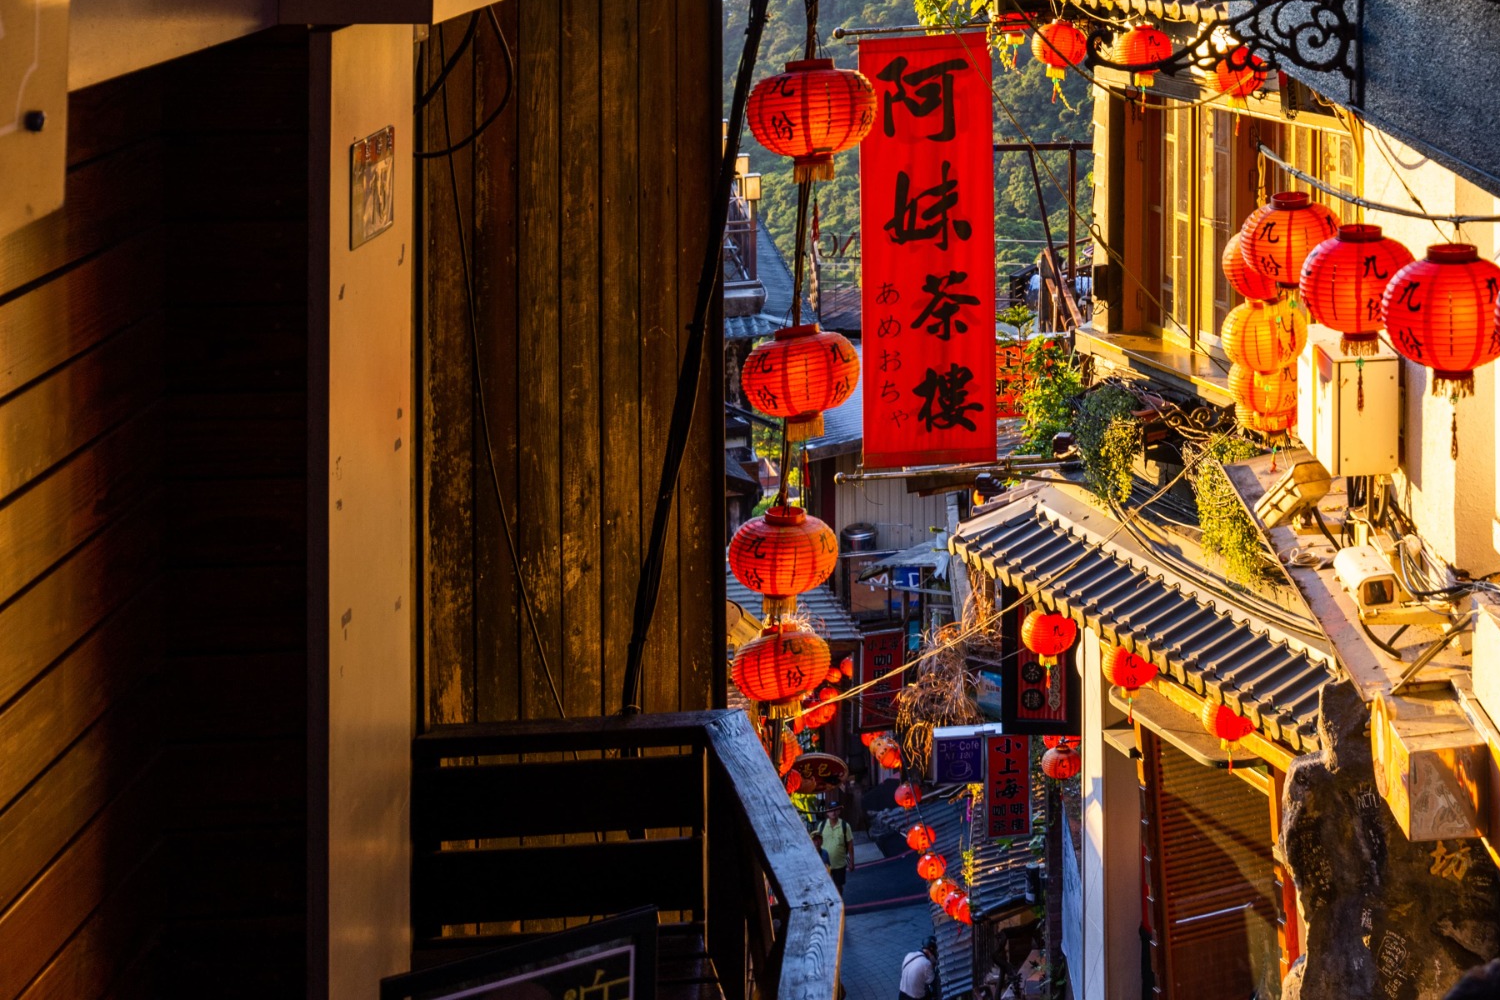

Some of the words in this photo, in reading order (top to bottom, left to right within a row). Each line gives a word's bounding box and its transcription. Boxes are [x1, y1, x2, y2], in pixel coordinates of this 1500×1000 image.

[769, 75, 796, 140] 九份
[876, 56, 984, 433] 阿妹茶樓
[1259, 221, 1281, 277] 九份
[1398, 280, 1423, 359] 九份
[753, 350, 778, 410] 九份
[830, 342, 851, 404] 九份
[876, 282, 909, 429] あめおちゃ
[745, 536, 766, 590] 九份
[782, 639, 805, 689] 九份
[1125, 655, 1138, 686] 九份
[994, 738, 1024, 799] 小上海
[992, 803, 1024, 817] 咖啡
[993, 818, 1024, 832] 茶樓
